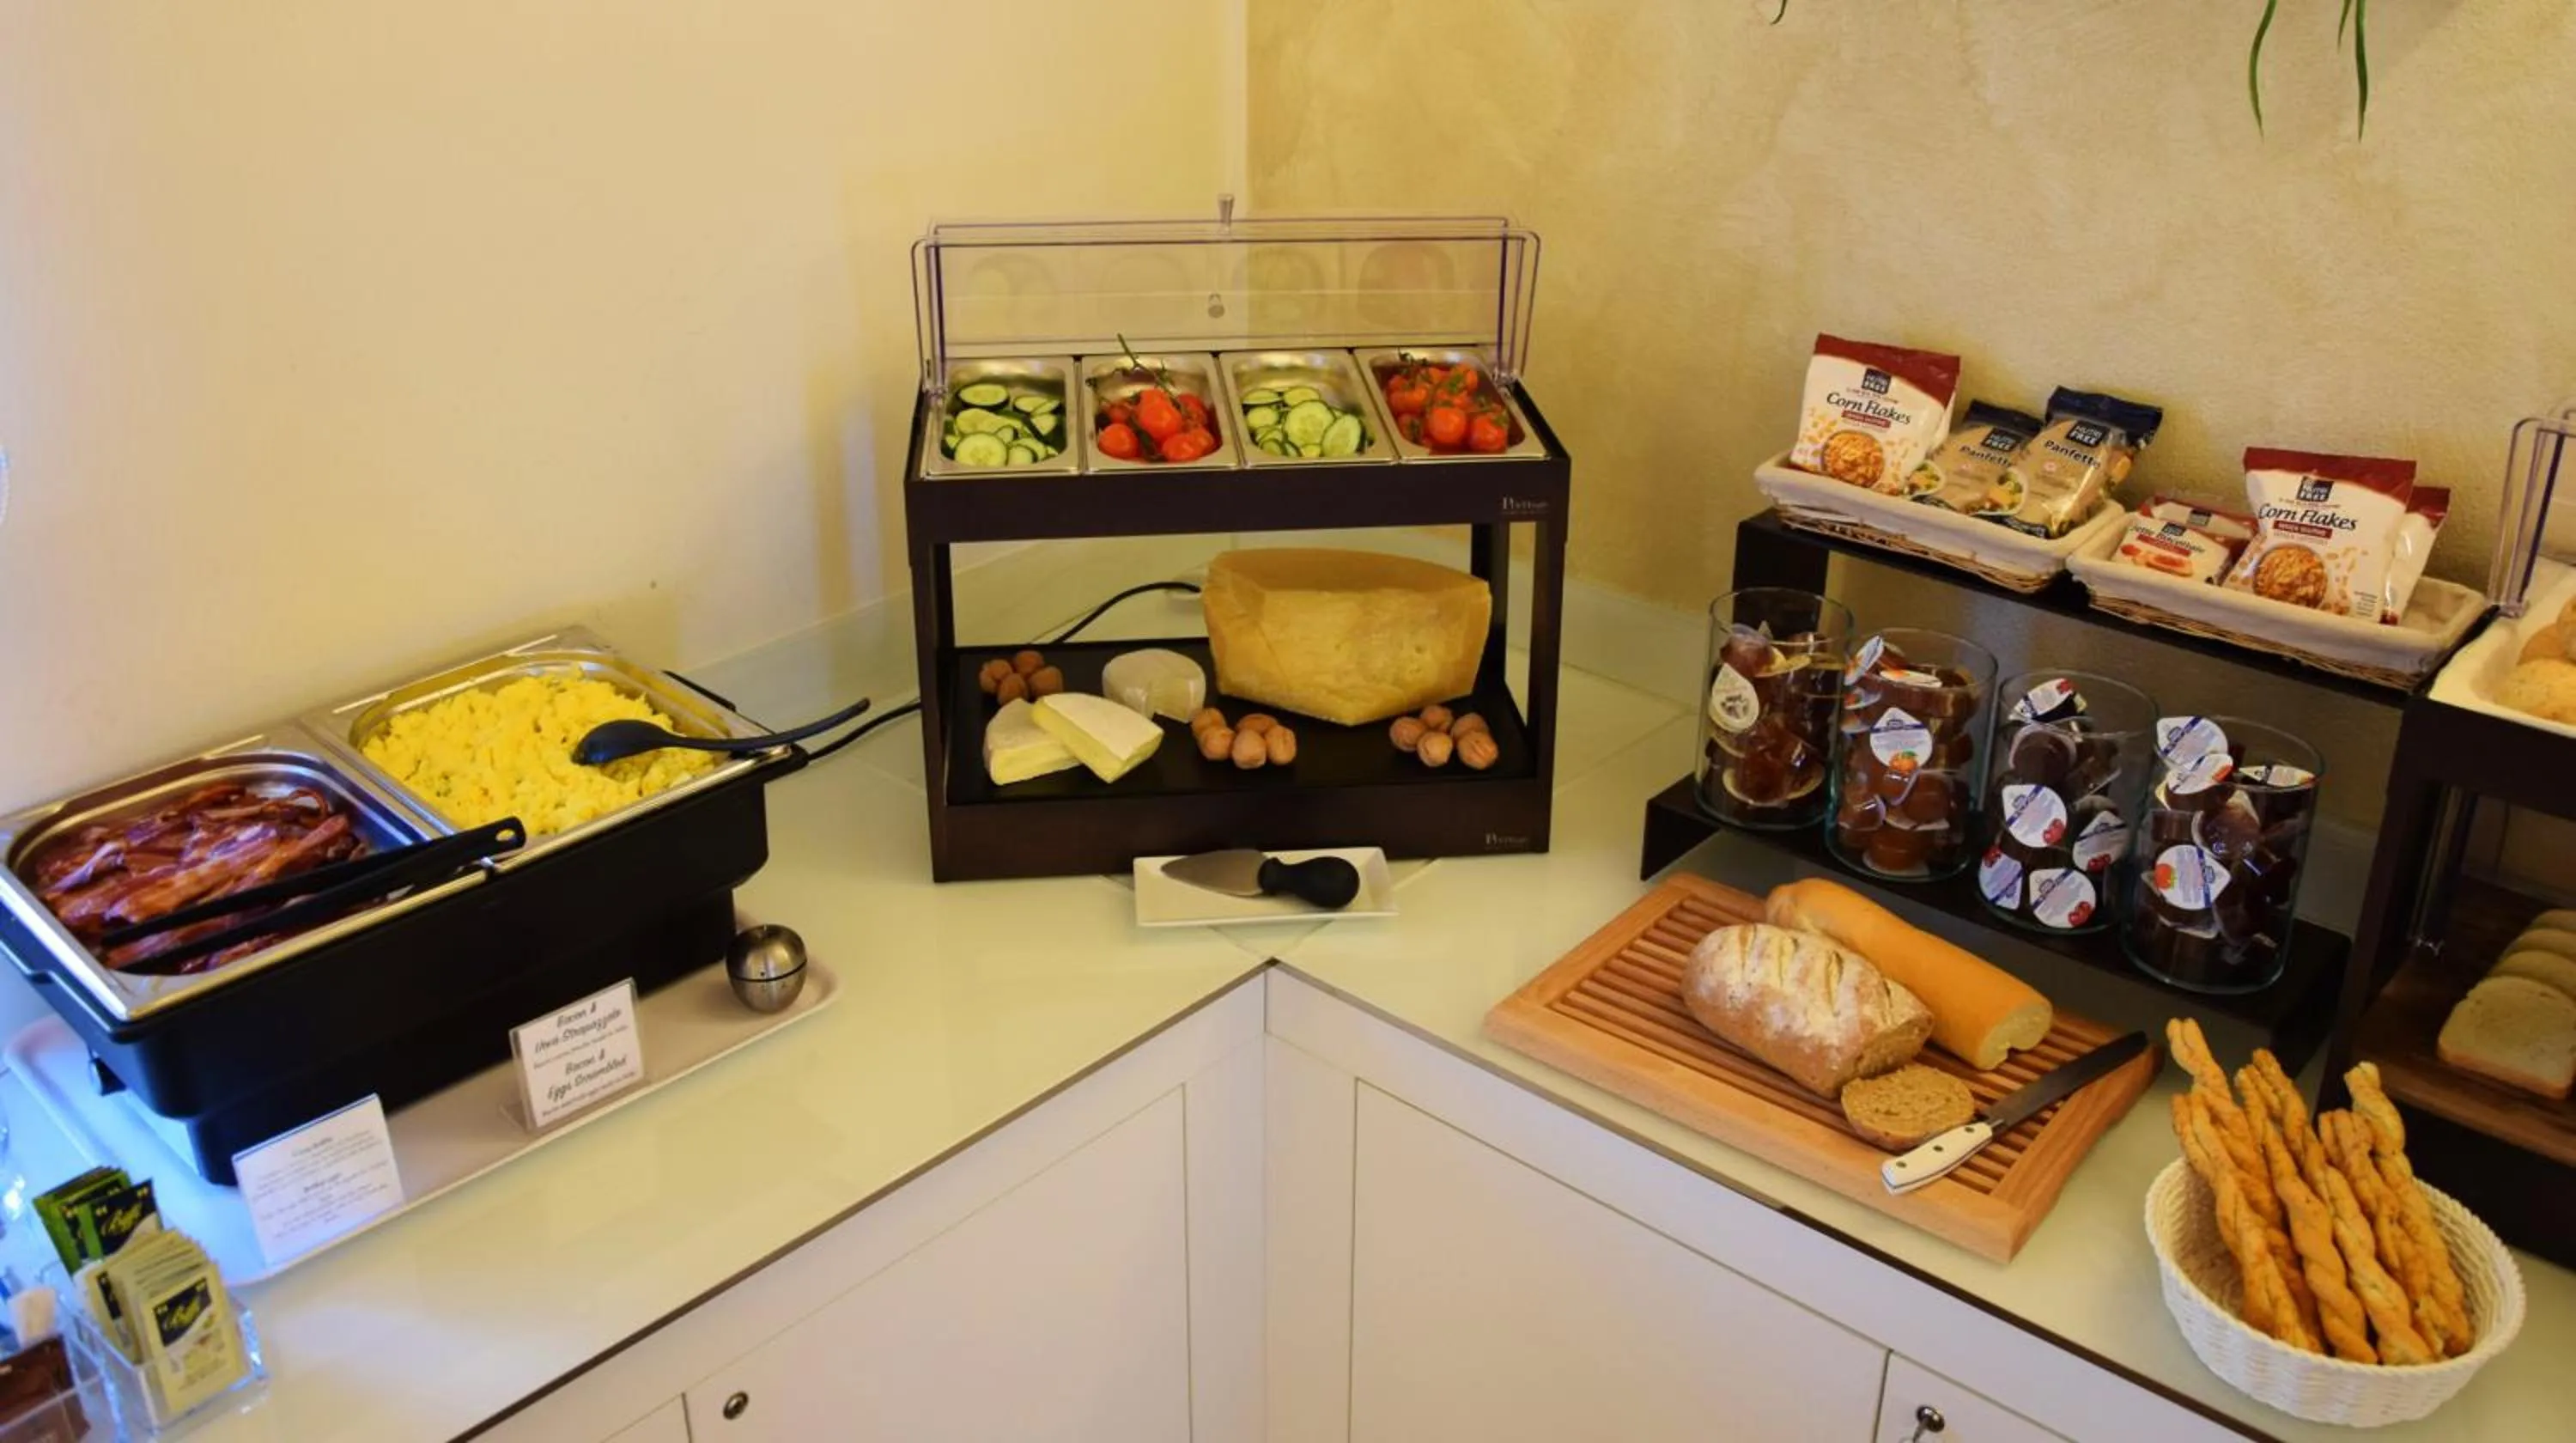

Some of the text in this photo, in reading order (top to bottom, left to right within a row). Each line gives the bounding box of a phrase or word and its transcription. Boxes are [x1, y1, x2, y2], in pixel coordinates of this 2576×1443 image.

[1826, 392, 1862, 411] Corn
[1864, 399, 1911, 425] Flakes
[2070, 431, 2099, 445] FREE
[2257, 503, 2297, 521] Corn
[2300, 509, 2359, 531] Flakes
